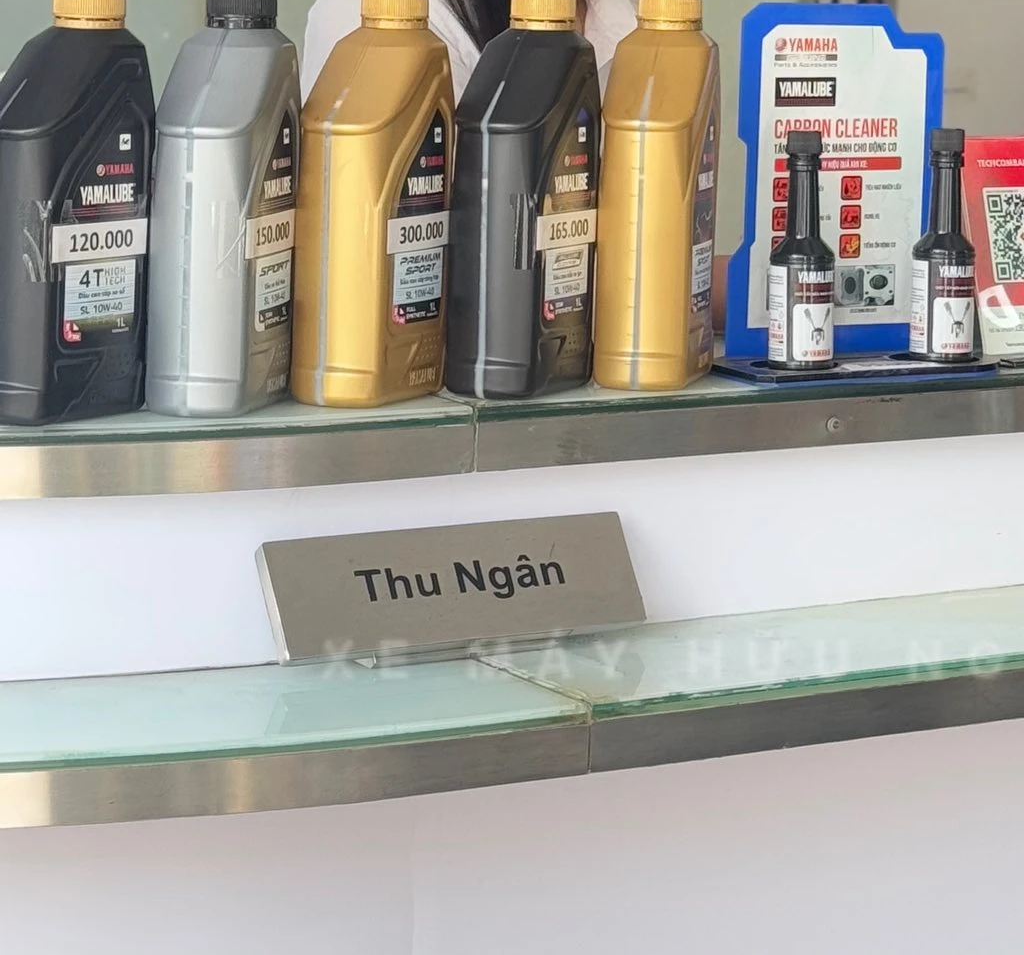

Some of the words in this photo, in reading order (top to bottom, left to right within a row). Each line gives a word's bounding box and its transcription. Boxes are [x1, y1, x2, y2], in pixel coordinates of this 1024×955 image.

[789, 37, 838, 52] YAMAHA
[779, 81, 835, 98] YAMALUBE
[835, 118, 898, 138] CLEANER
[854, 142, 867, 153] CHO
[105, 163, 134, 176] YAMAHA
[407, 174, 444, 196] YAMALUBE
[555, 173, 589, 194] YAMALUBE
[80, 183, 135, 206] YAMALUBE
[256, 220, 290, 246] 150.000
[399, 220, 444, 244] 300.000
[549, 218, 589, 241] 165.000
[69, 228, 134, 254] 120.000
[259, 260, 290, 277] SPORT
[400, 252, 440, 266] PREMIUM
[405, 262, 437, 276] SPORT
[79, 268, 104, 288] 4T
[80, 306, 90, 315] SL
[94, 301, 123, 314] 10W-40
[354, 567, 441, 602] Thu
[454, 554, 566, 599] Ngân
